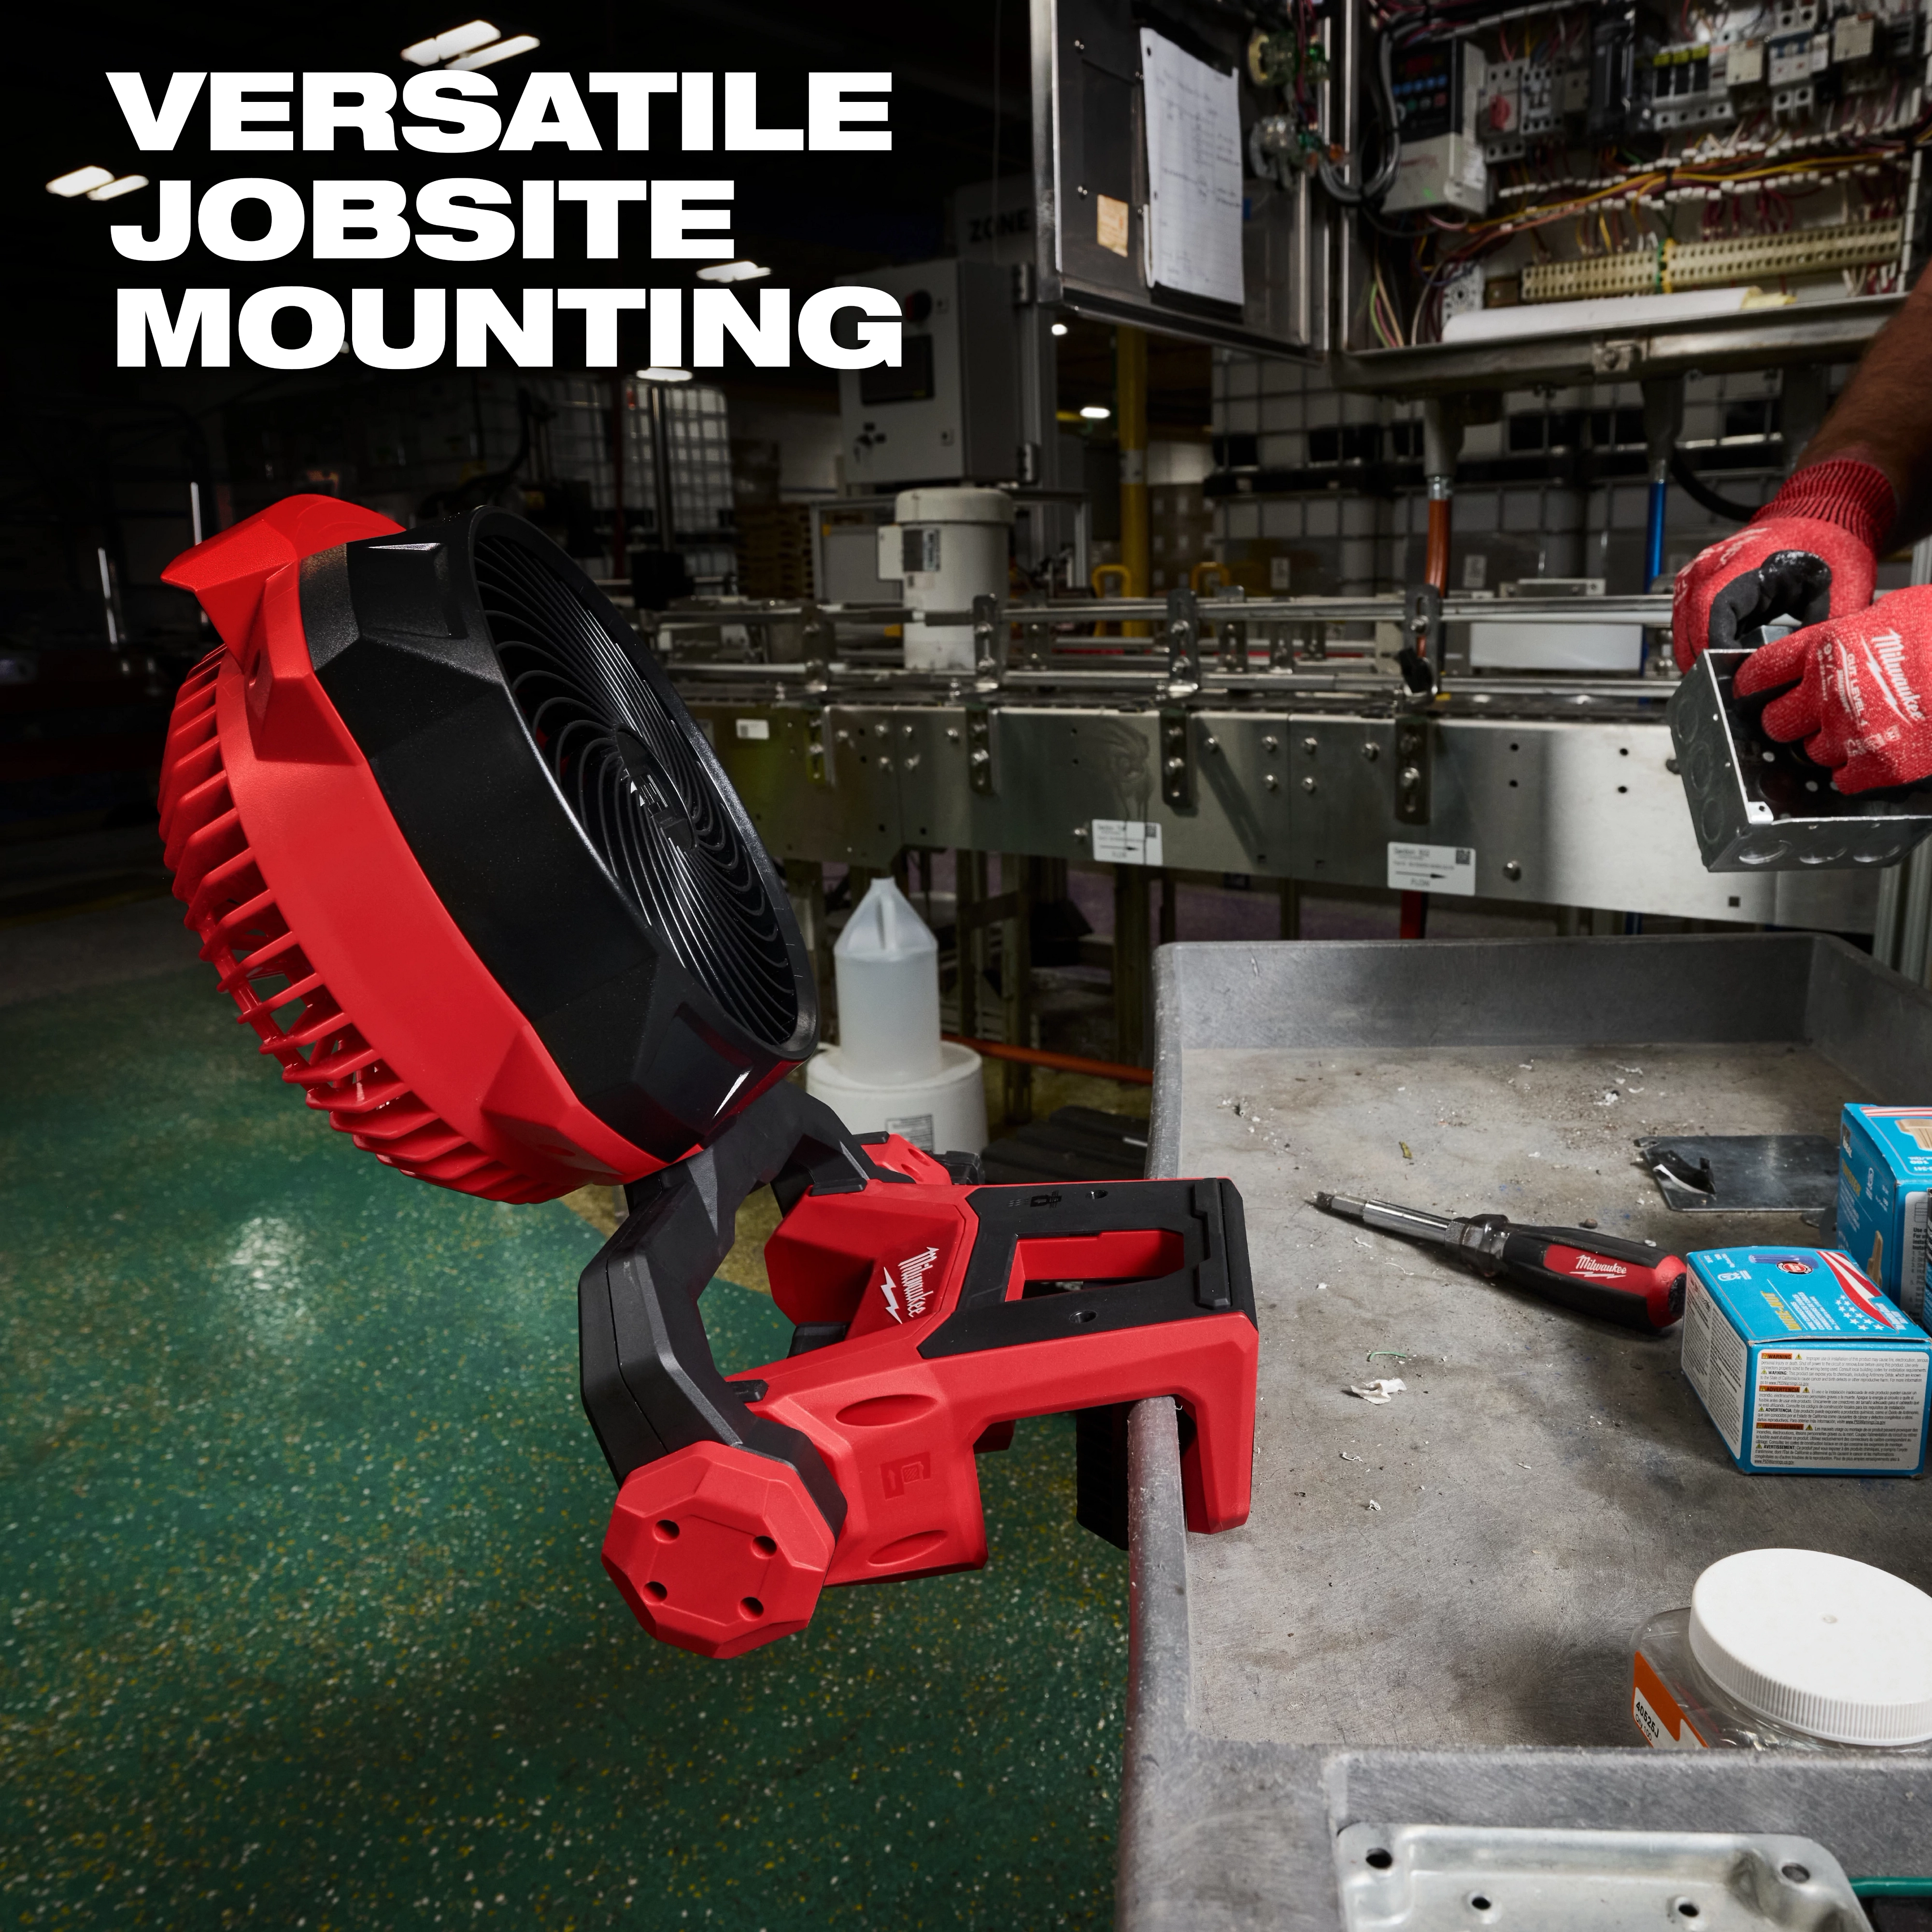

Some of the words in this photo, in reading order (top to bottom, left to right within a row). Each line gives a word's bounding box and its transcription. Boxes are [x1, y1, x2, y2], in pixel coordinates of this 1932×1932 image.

[1847, 653, 1857, 676] CUT
[1871, 628, 1925, 721] Milwaukee
[1851, 679, 1864, 716] LEVEL
[897, 1247, 939, 1318] Milwaukee
[1576, 1255, 1627, 1274] Milwaukee
[1760, 1291, 1802, 1331] WIRE-NUT
[1636, 1702, 1659, 1738] 40525J
